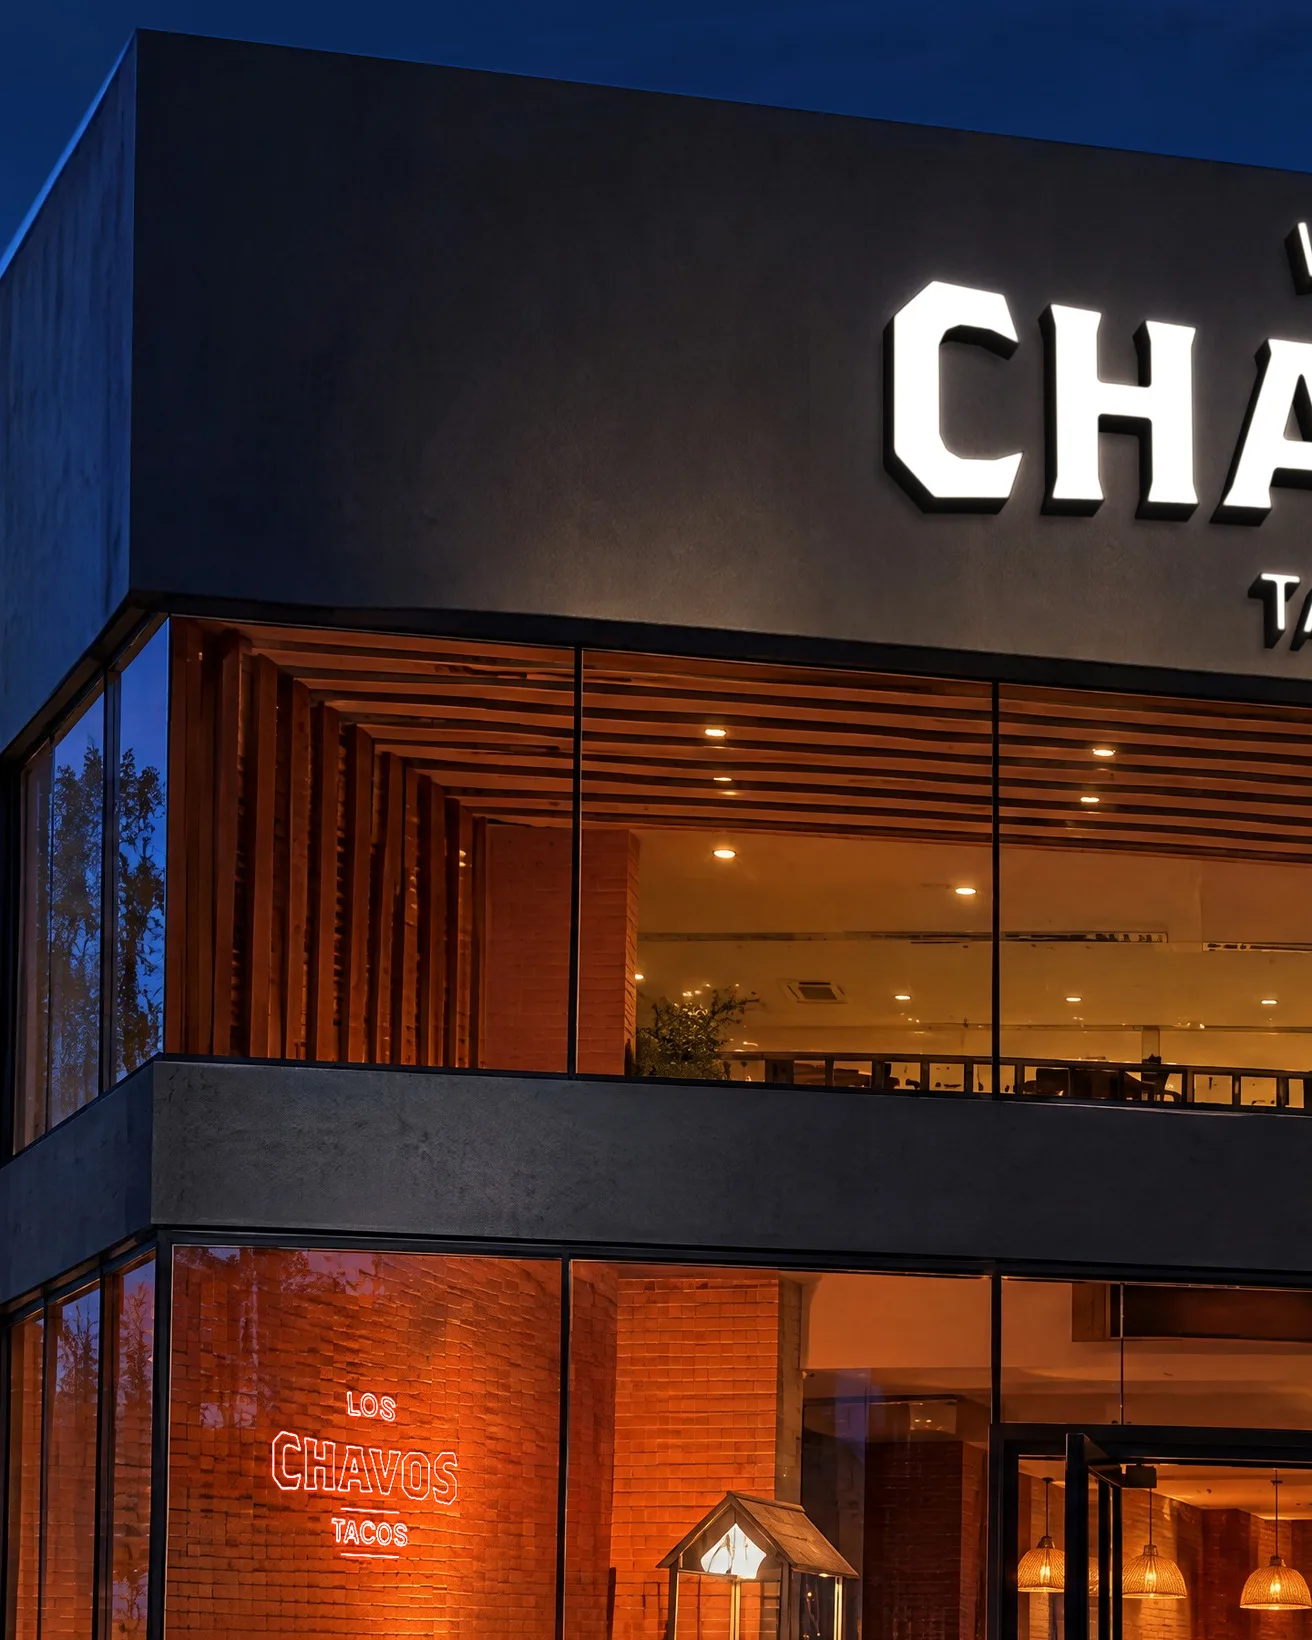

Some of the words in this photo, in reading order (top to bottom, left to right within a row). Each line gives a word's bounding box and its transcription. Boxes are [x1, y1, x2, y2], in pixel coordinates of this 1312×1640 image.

[346, 1390, 397, 1422] LOS
[271, 1430, 458, 1506] CHAVOS
[331, 1517, 408, 1548] TACOS
